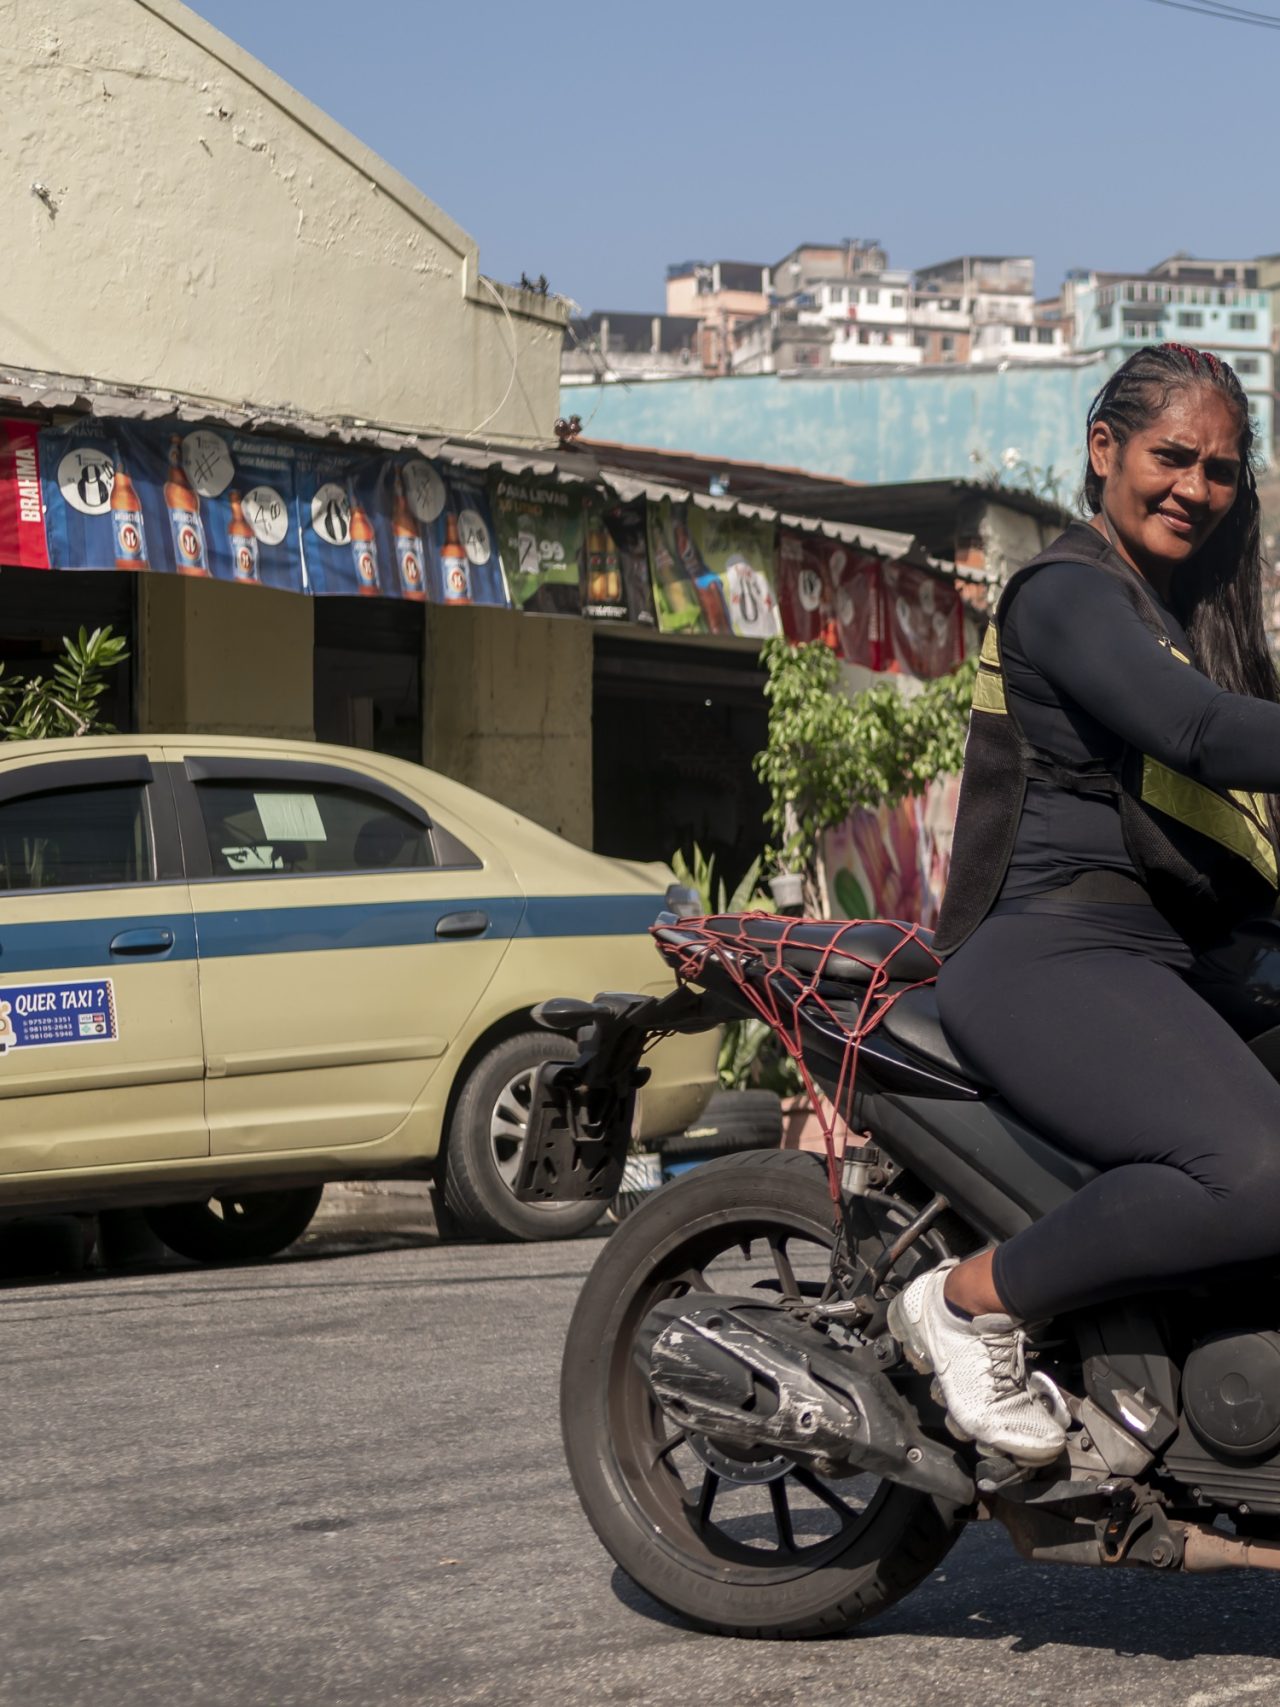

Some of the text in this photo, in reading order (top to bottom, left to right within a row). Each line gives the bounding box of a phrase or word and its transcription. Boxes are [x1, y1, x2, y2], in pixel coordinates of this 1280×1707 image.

[15, 449, 41, 522] BRAHMA
[15, 988, 105, 1017] QUER TAXI ?
